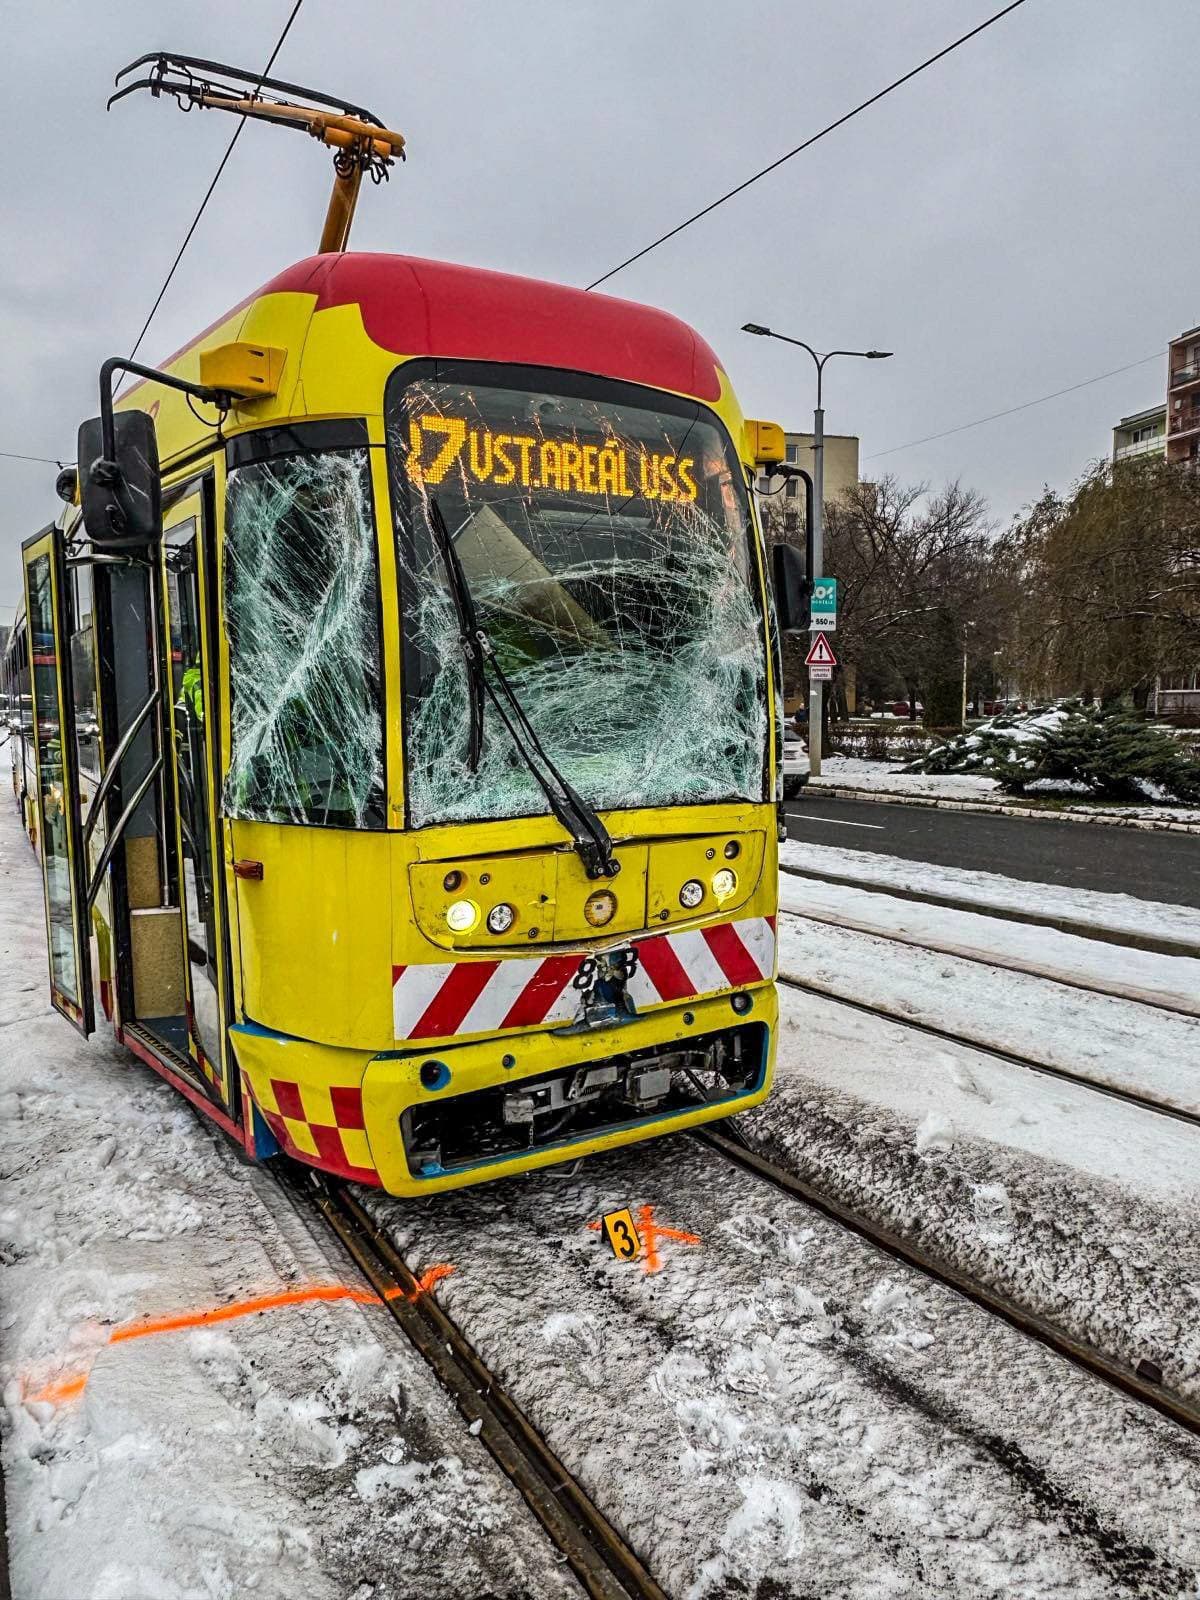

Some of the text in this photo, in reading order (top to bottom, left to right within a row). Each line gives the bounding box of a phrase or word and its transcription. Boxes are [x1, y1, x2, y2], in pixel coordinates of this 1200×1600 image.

[405, 415, 466, 484] 7
[640, 453, 697, 501] USS
[613, 1220, 635, 1257] 3
